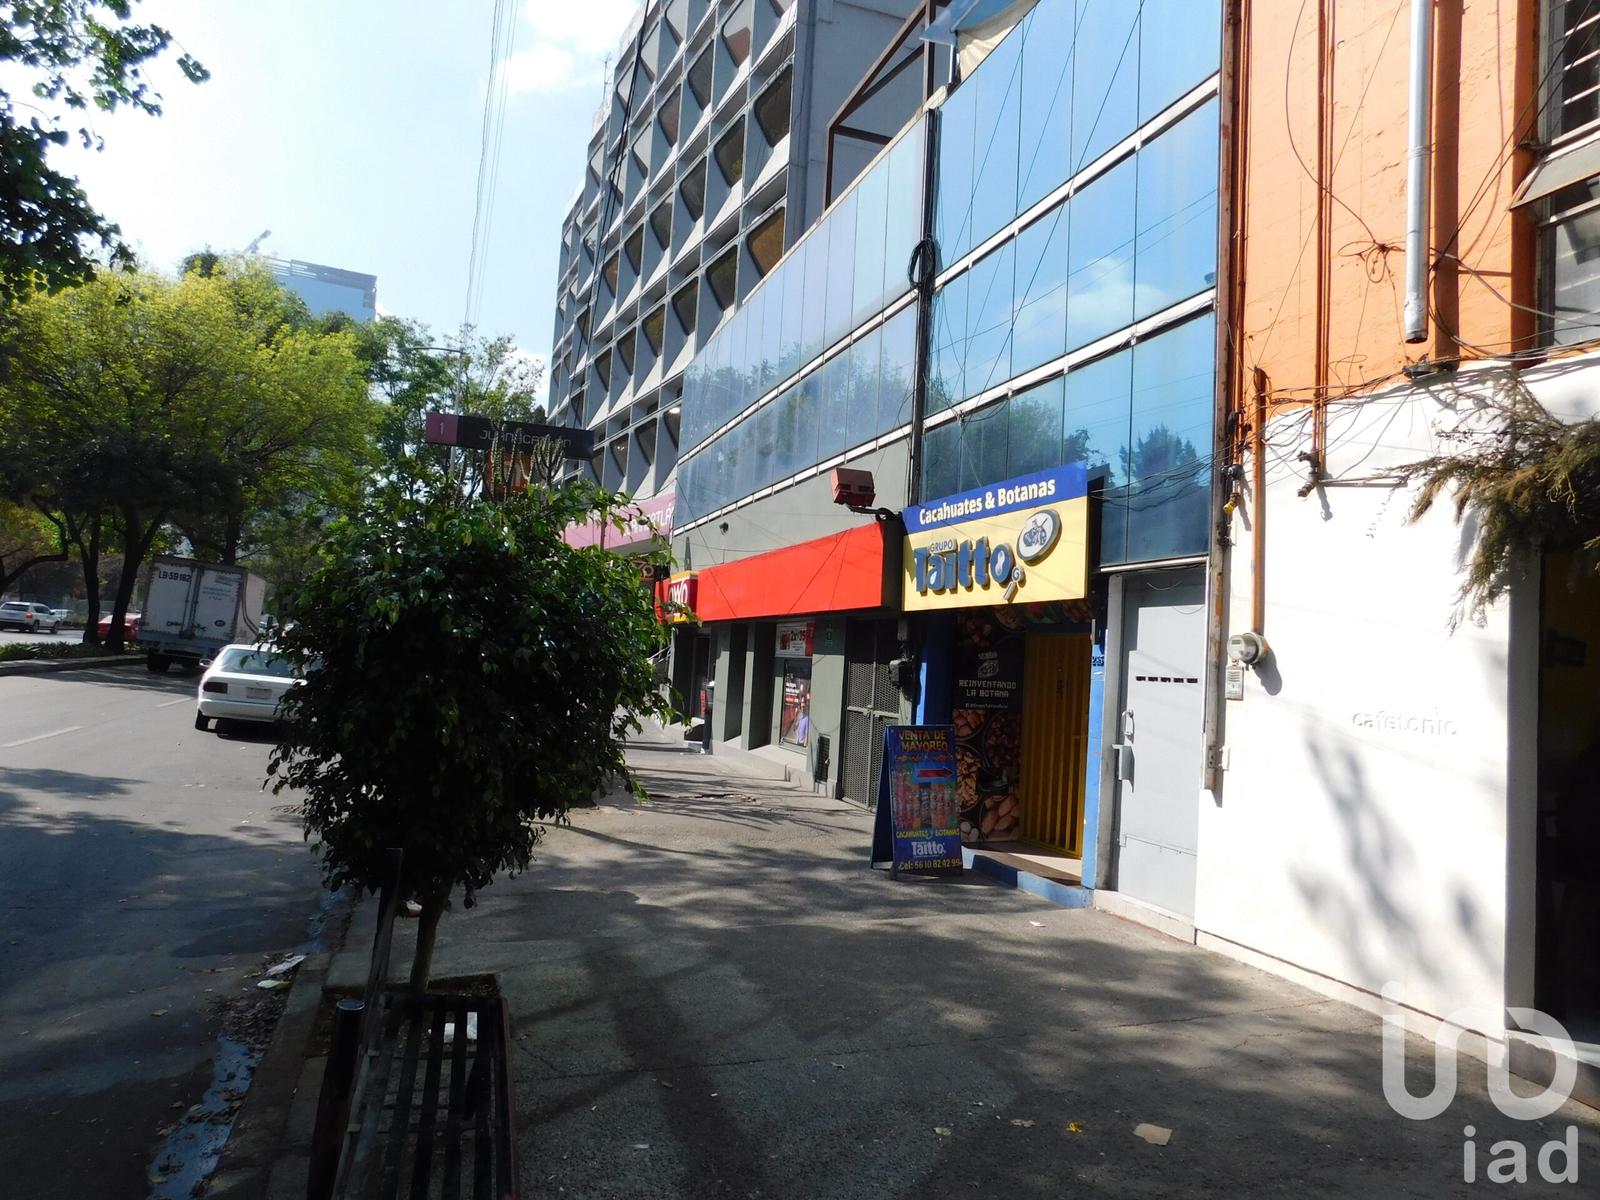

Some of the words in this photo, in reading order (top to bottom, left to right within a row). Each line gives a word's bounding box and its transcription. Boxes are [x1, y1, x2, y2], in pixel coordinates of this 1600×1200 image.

[919, 499, 984, 525] Cacahuates
[985, 491, 996, 510] &
[998, 479, 1057, 507] Botanas
[929, 539, 955, 551] GRUPO
[914, 536, 1014, 594] Taitto
[958, 679, 1018, 689] REINVENTANDO
[966, 689, 977, 697] LA
[979, 689, 1009, 698] BOTANA
